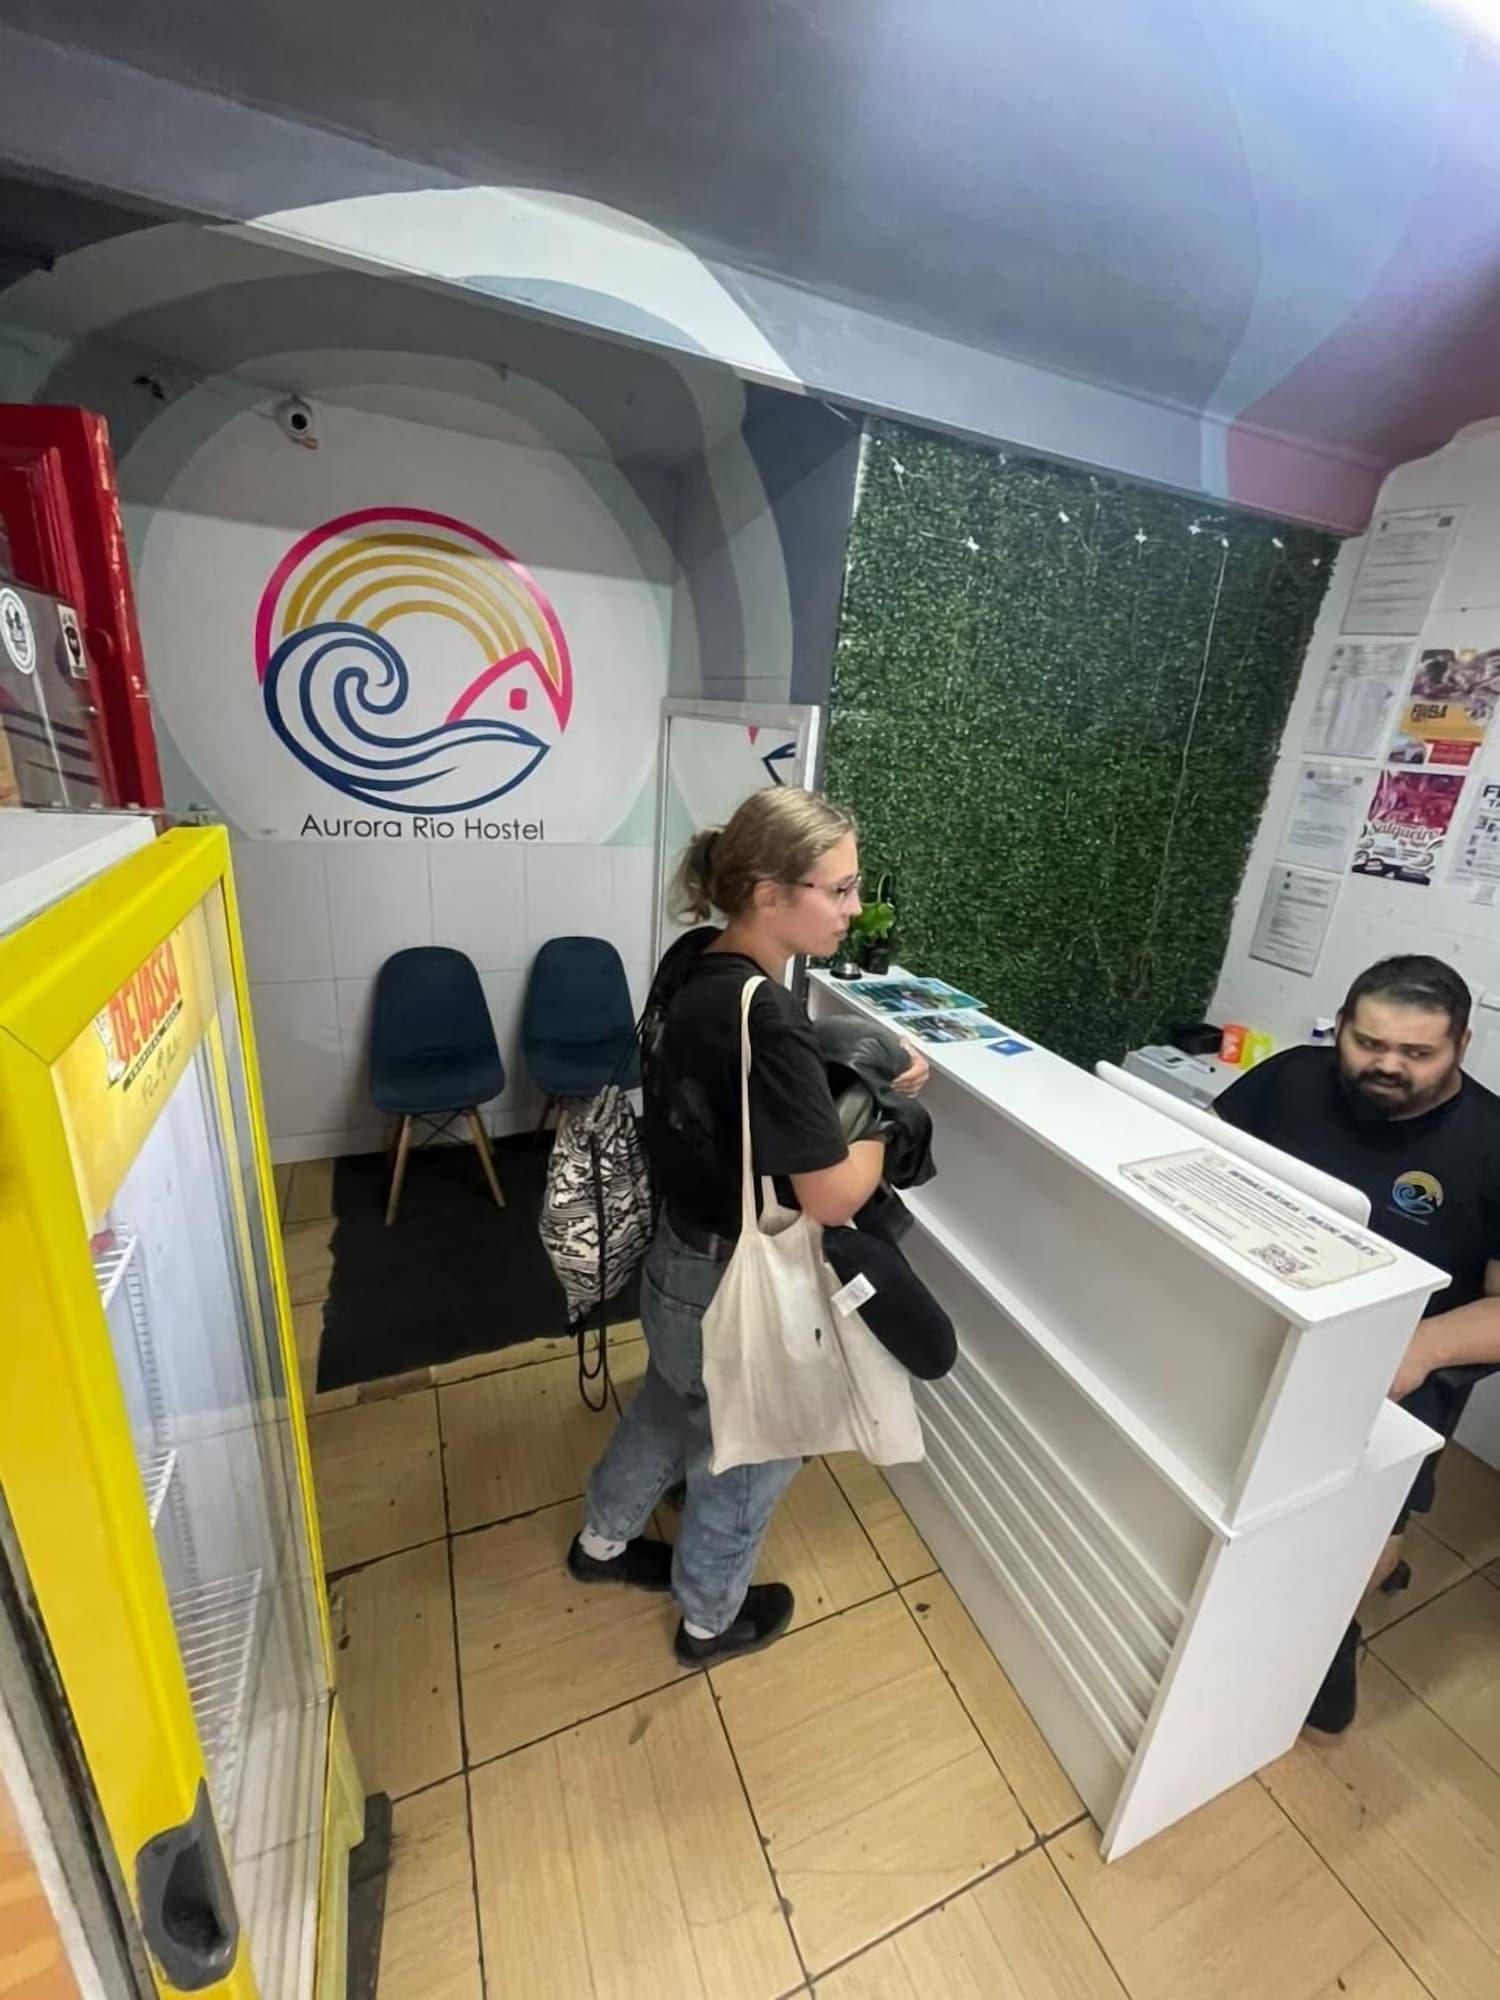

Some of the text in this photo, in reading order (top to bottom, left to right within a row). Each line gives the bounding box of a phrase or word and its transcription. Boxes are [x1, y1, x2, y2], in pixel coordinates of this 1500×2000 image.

[1482, 784, 1500, 798] F
[300, 814, 544, 840] Aurora Rio Hostel
[107, 937, 181, 1064] DEVASSA
